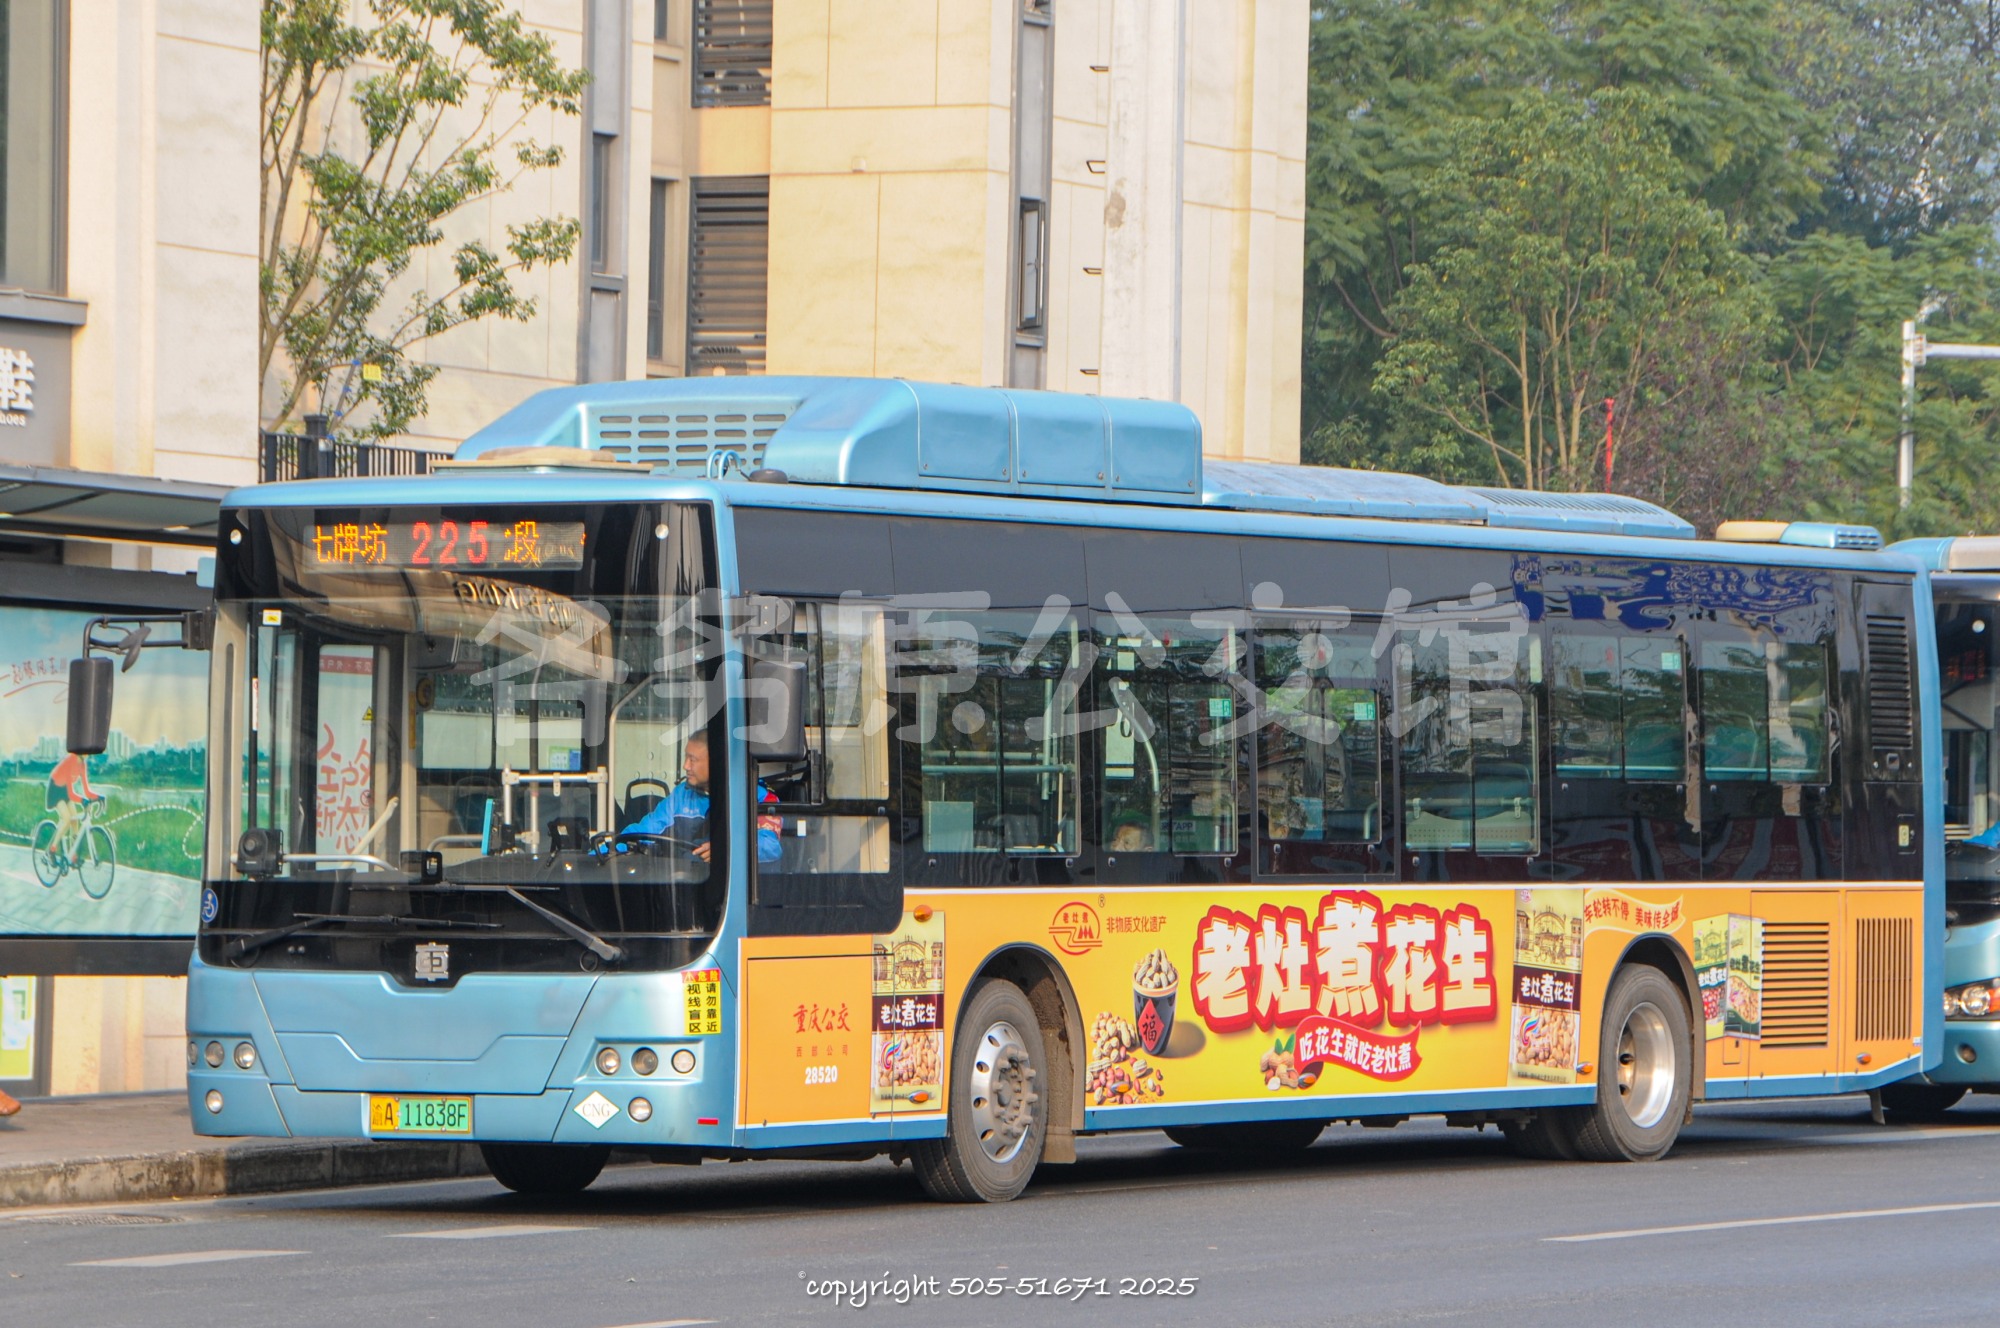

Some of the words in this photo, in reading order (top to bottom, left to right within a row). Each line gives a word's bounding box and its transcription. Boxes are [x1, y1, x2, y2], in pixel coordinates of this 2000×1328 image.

[312, 522, 388, 564] 七牌坊
[411, 520, 488, 564] 225
[1106, 915, 1167, 934] 非物质文化遗产
[1194, 894, 1493, 1021] 老灶煮花生
[1520, 972, 1575, 1004] 老灶煮花生
[687, 983, 702, 1034] 视线盲区
[706, 982, 718, 1033] 请勿靠近
[793, 1002, 852, 1034] 重庆公交
[880, 997, 937, 1027] 老灶煮花生
[1299, 1026, 1412, 1075] 吃花生就吃老灶煮
[804, 1064, 838, 1085] 28520
[582, 1103, 611, 1118] CNG
